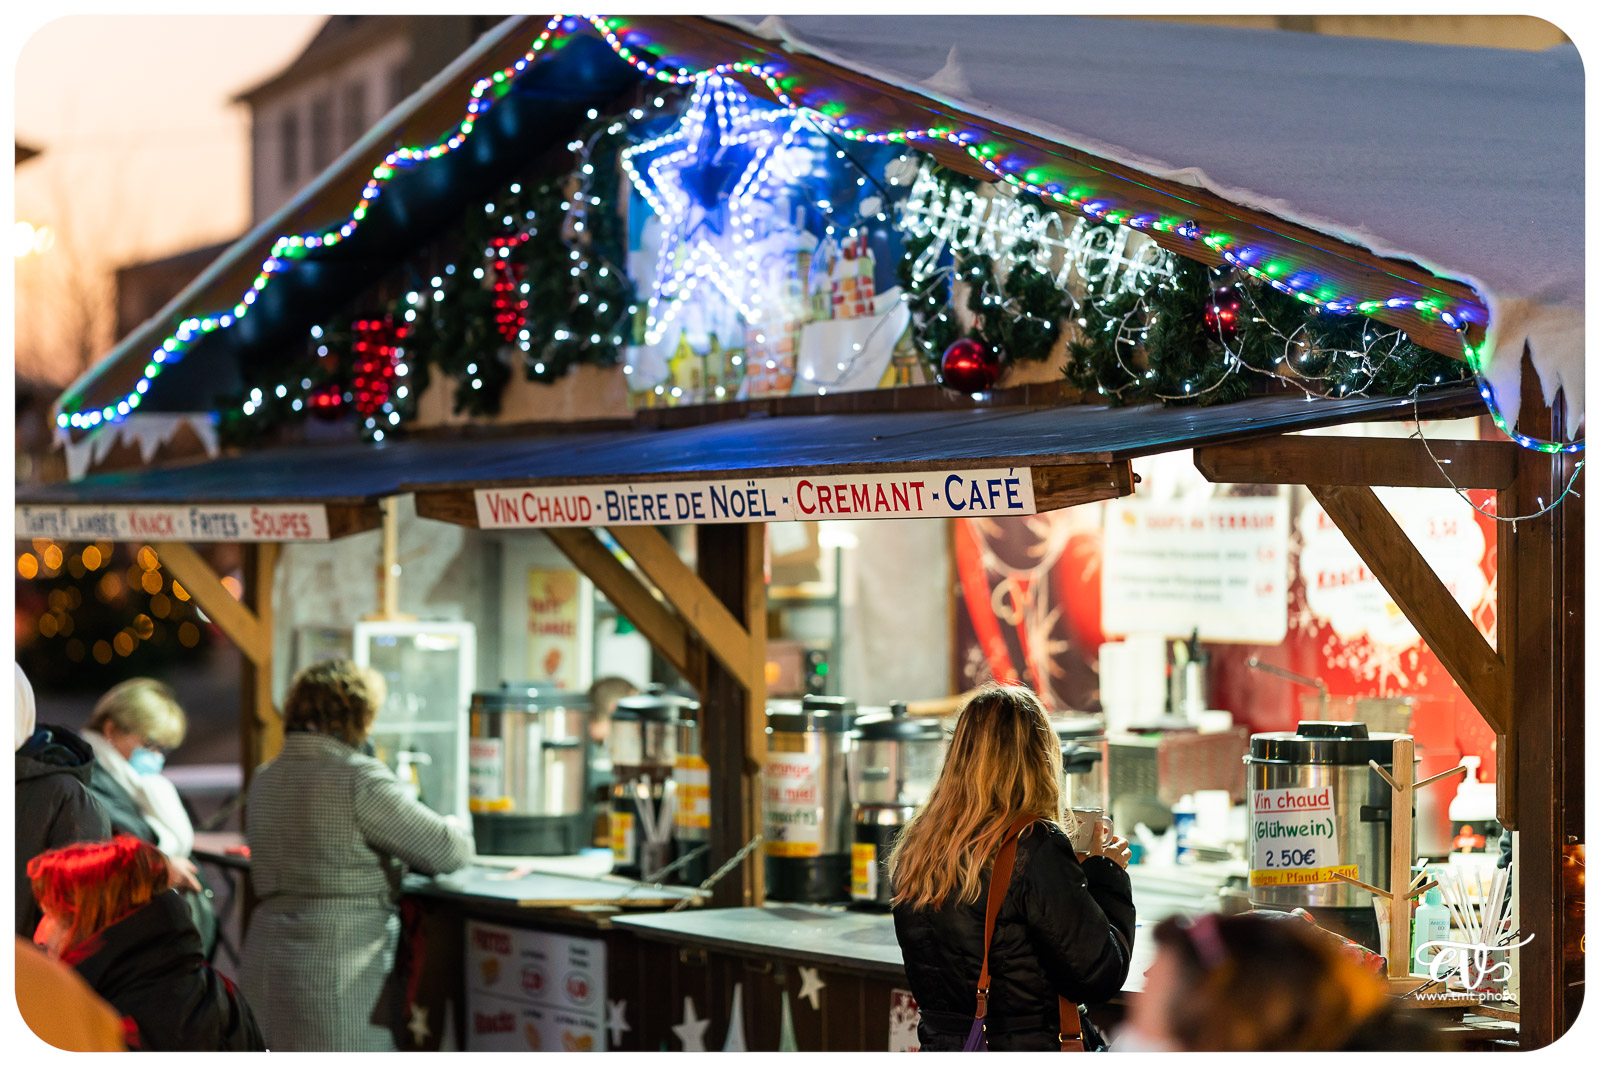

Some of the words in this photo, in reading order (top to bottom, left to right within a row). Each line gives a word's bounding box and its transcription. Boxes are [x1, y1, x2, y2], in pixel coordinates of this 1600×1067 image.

[486, 491, 520, 524] VIN
[522, 491, 592, 524] CHAUD
[606, 484, 670, 521] BIÈRE
[675, 491, 704, 521] DE
[708, 479, 777, 519] NOËL
[796, 478, 925, 516] CREMANT
[943, 467, 1024, 512] CAFÉ
[128, 509, 174, 537] KNACK
[190, 508, 239, 538] FRITES
[251, 507, 312, 539] SOUPES
[1254, 793, 1271, 810] Vin
[1277, 788, 1329, 809] chaud
[1255, 817, 1334, 843] (Glühwein)
[1265, 848, 1316, 868] 2.50€
[1287, 870, 1319, 884] Pfand
